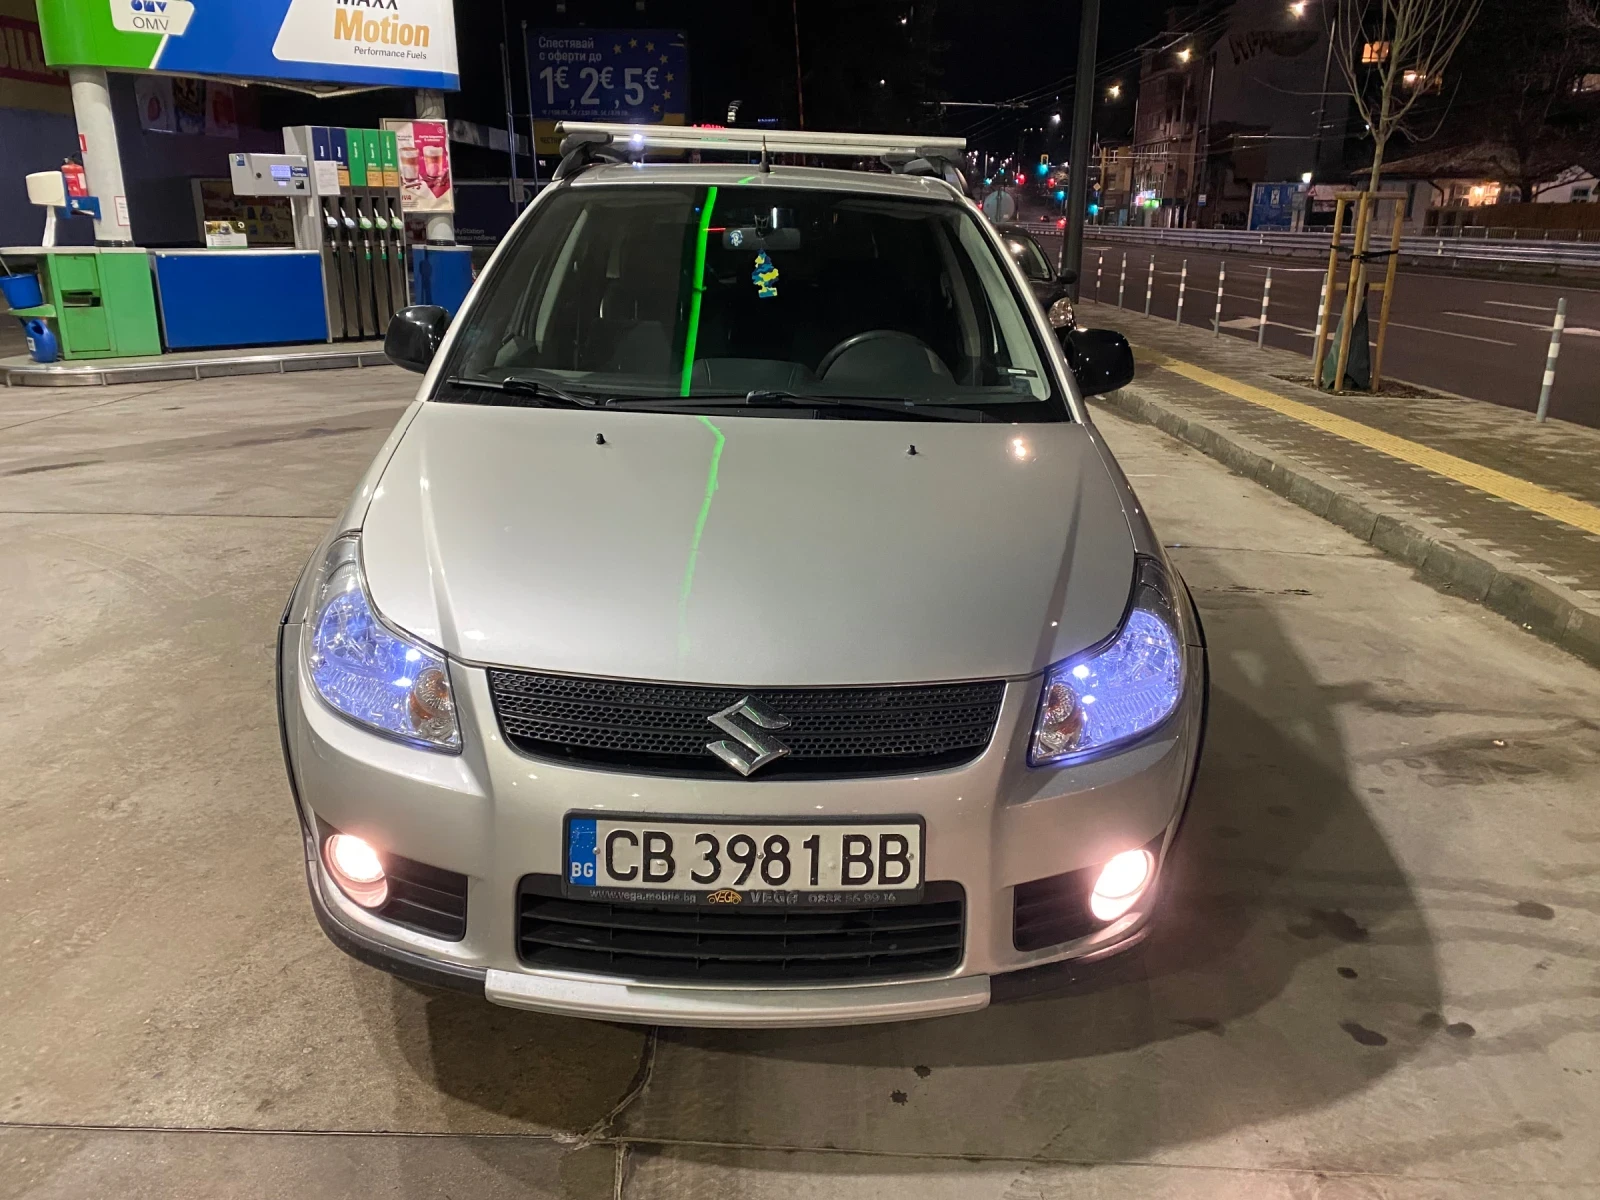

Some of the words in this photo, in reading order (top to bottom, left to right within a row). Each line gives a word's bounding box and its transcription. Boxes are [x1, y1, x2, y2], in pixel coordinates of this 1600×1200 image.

[133, 16, 169, 31] OMV
[334, 8, 430, 47] Motion
[538, 36, 595, 49] Спестявай
[354, 46, 405, 58] Performance
[406, 50, 427, 60] Fuels
[539, 53, 546, 61] с
[548, 49, 587, 64] оферти
[588, 52, 602, 63] до
[605, 829, 676, 883] CB
[690, 833, 820, 886] 3981
[841, 834, 911, 885] BB
[571, 861, 594, 878] BG
[749, 890, 799, 904] VEGA
